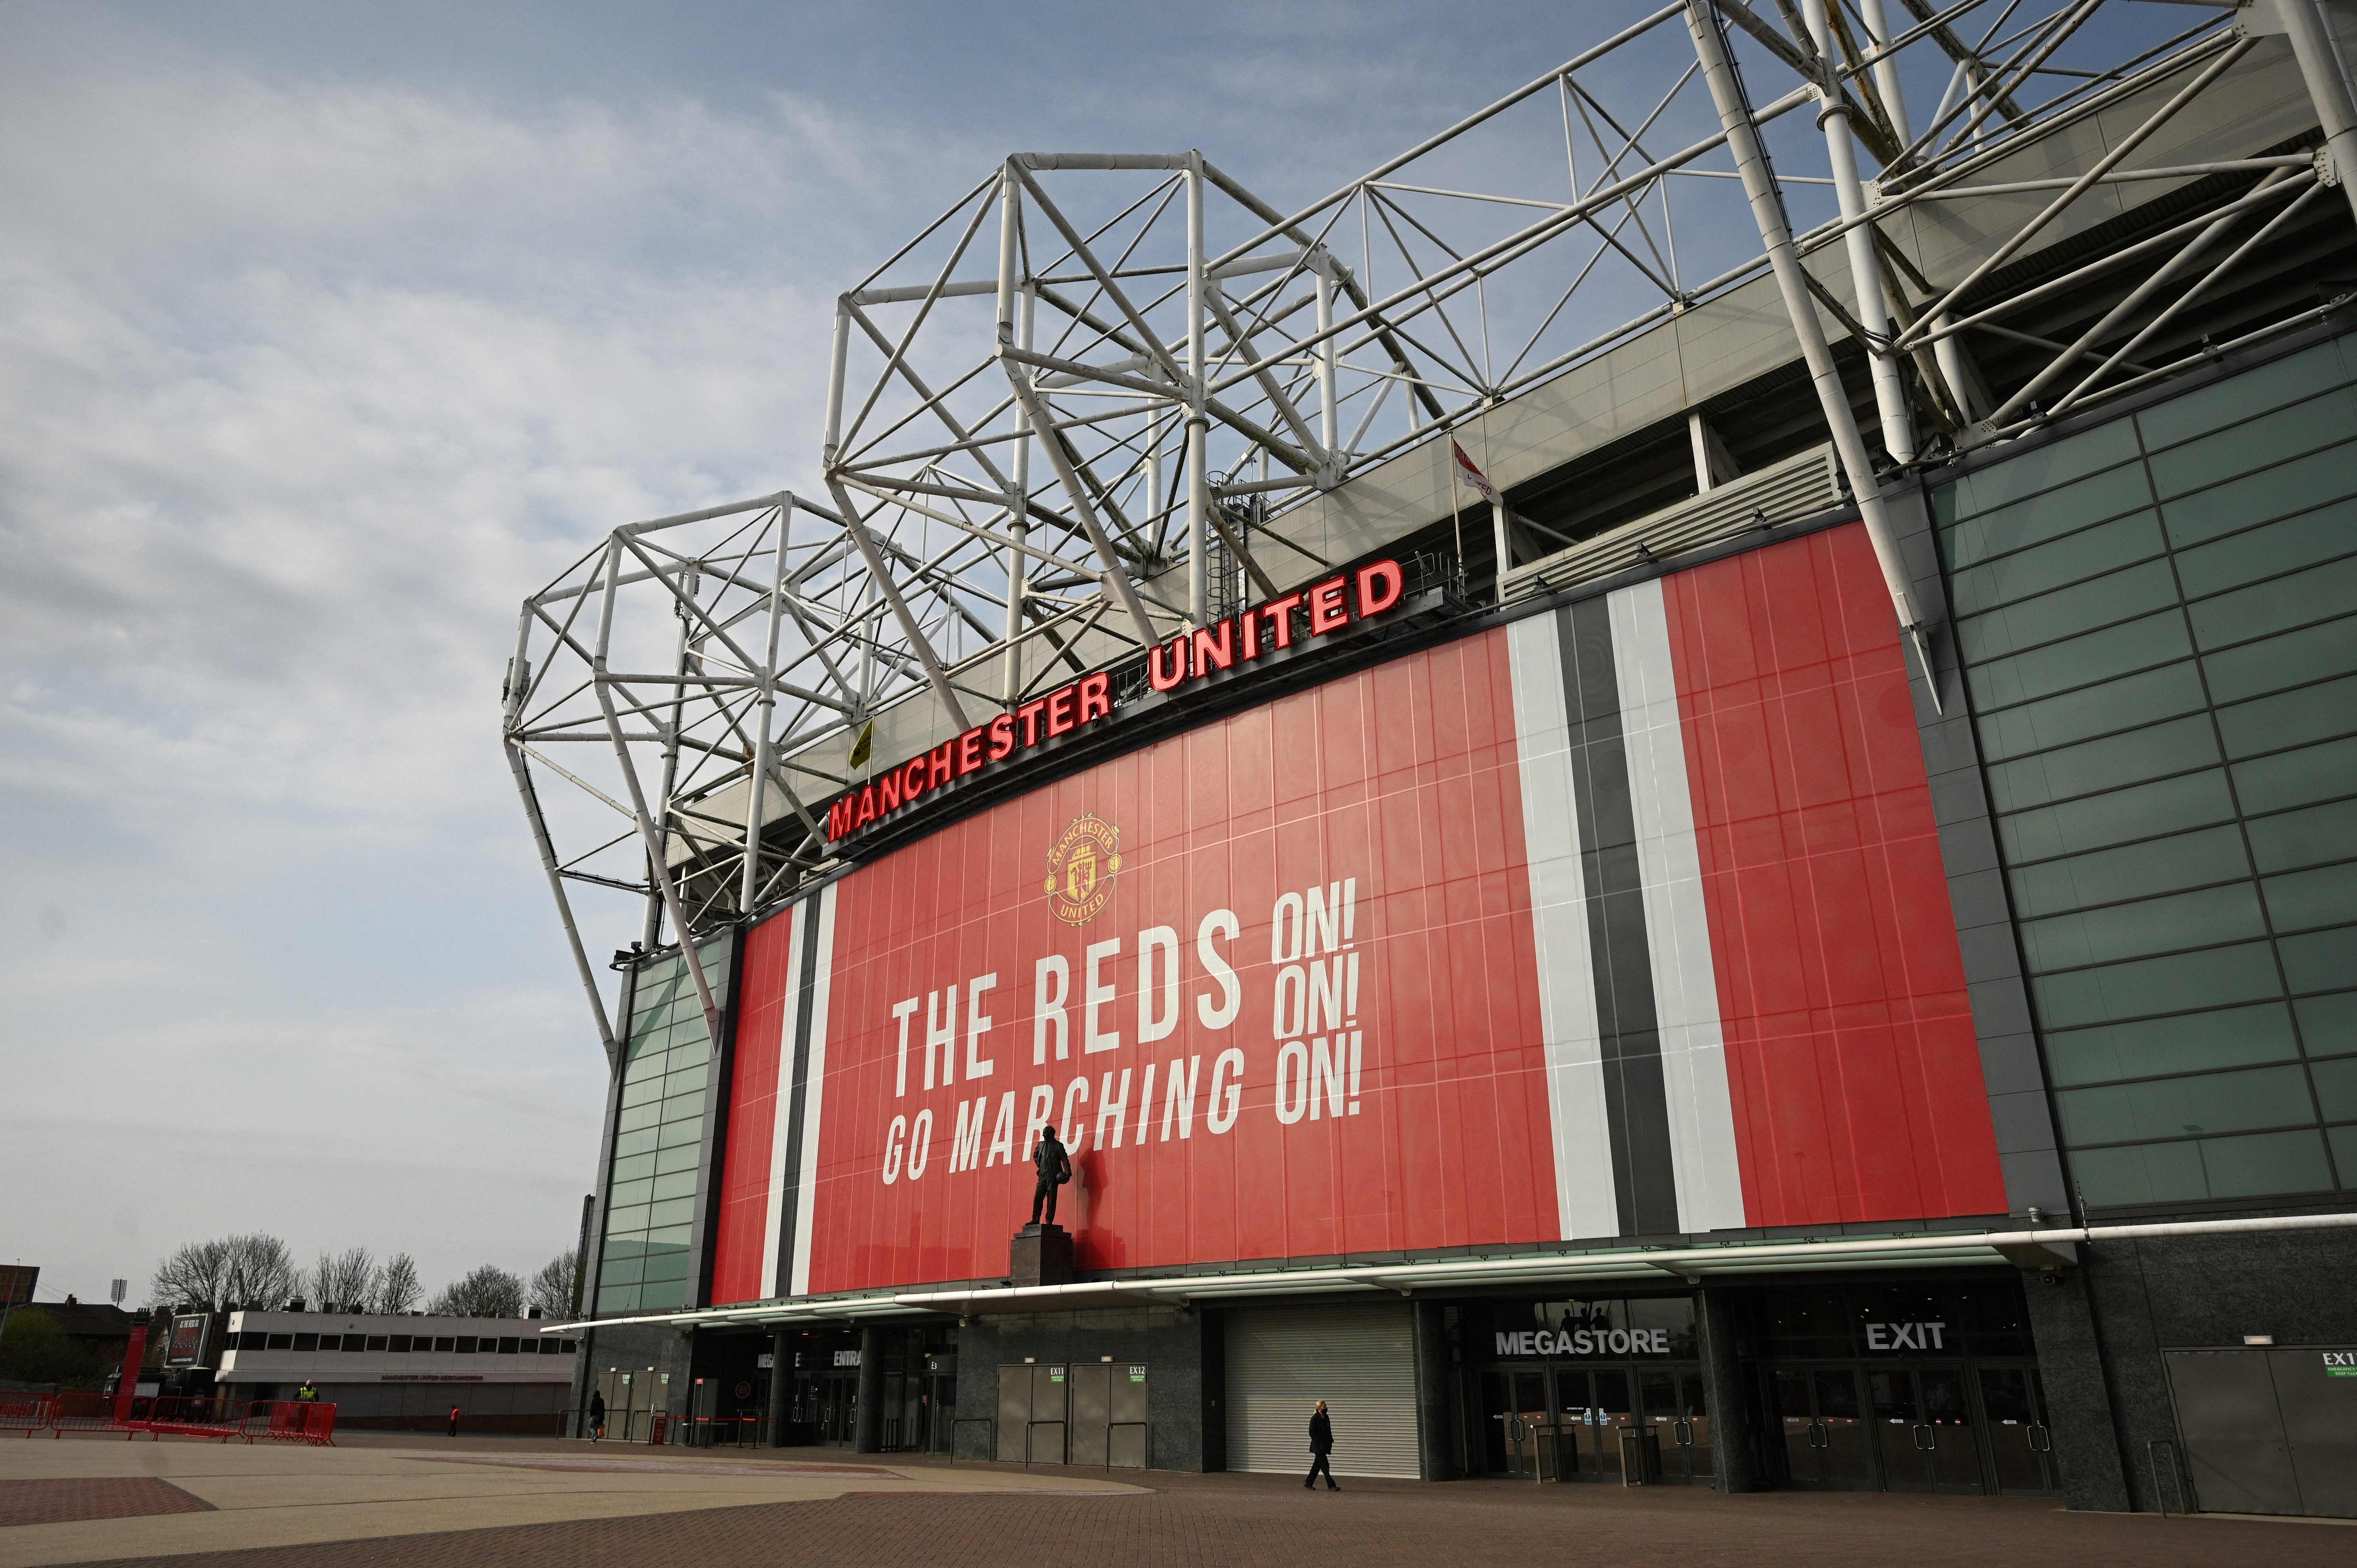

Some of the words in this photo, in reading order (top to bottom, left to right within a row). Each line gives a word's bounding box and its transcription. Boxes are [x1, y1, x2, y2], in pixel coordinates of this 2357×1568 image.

[828, 672, 1111, 842] MANCHESTER
[1149, 559, 1403, 692] UNITED
[1052, 821, 1114, 866] MANCHESTER
[1060, 893, 1104, 918] UNITED
[1272, 877, 1356, 964] ON!
[893, 972, 997, 1097] THE
[1034, 909, 1241, 1066] REDS
[1274, 952, 1359, 1040] ON!
[883, 1109, 933, 1185] GO
[949, 1048, 1245, 1173] MARCHING
[1276, 1031, 1362, 1125] ON!
[1496, 1328, 1670, 1355] MEGASTORE
[1866, 1322, 1946, 1349] EXIT
[2322, 1353, 2357, 1365] EX1
